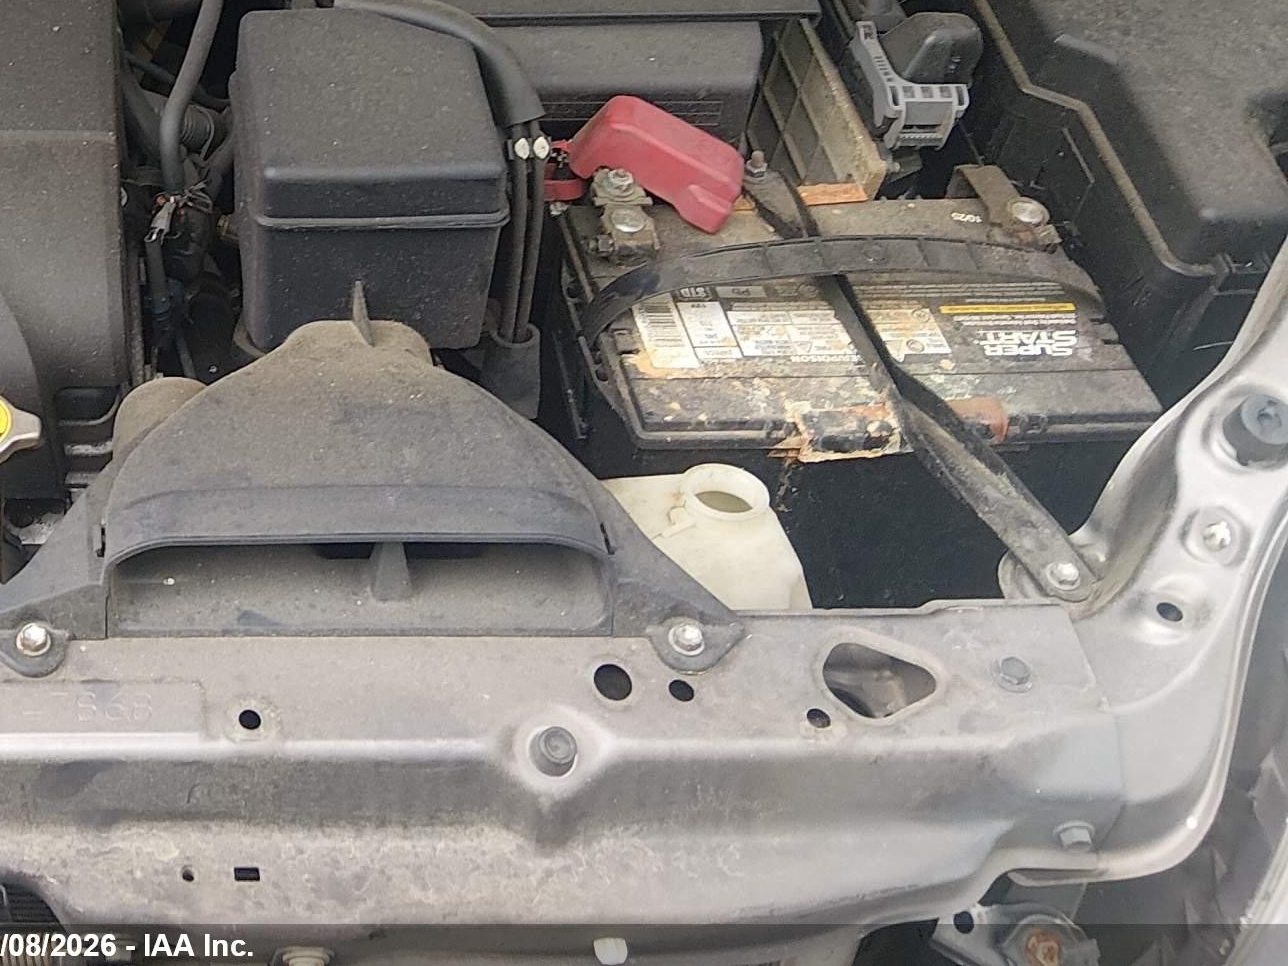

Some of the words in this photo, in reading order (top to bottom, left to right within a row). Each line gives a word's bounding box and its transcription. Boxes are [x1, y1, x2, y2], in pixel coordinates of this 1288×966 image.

[951, 212, 983, 223] 10/25
[679, 287, 707, 298] STD
[979, 330, 1077, 346] START
[983, 344, 1073, 356] SUPER
